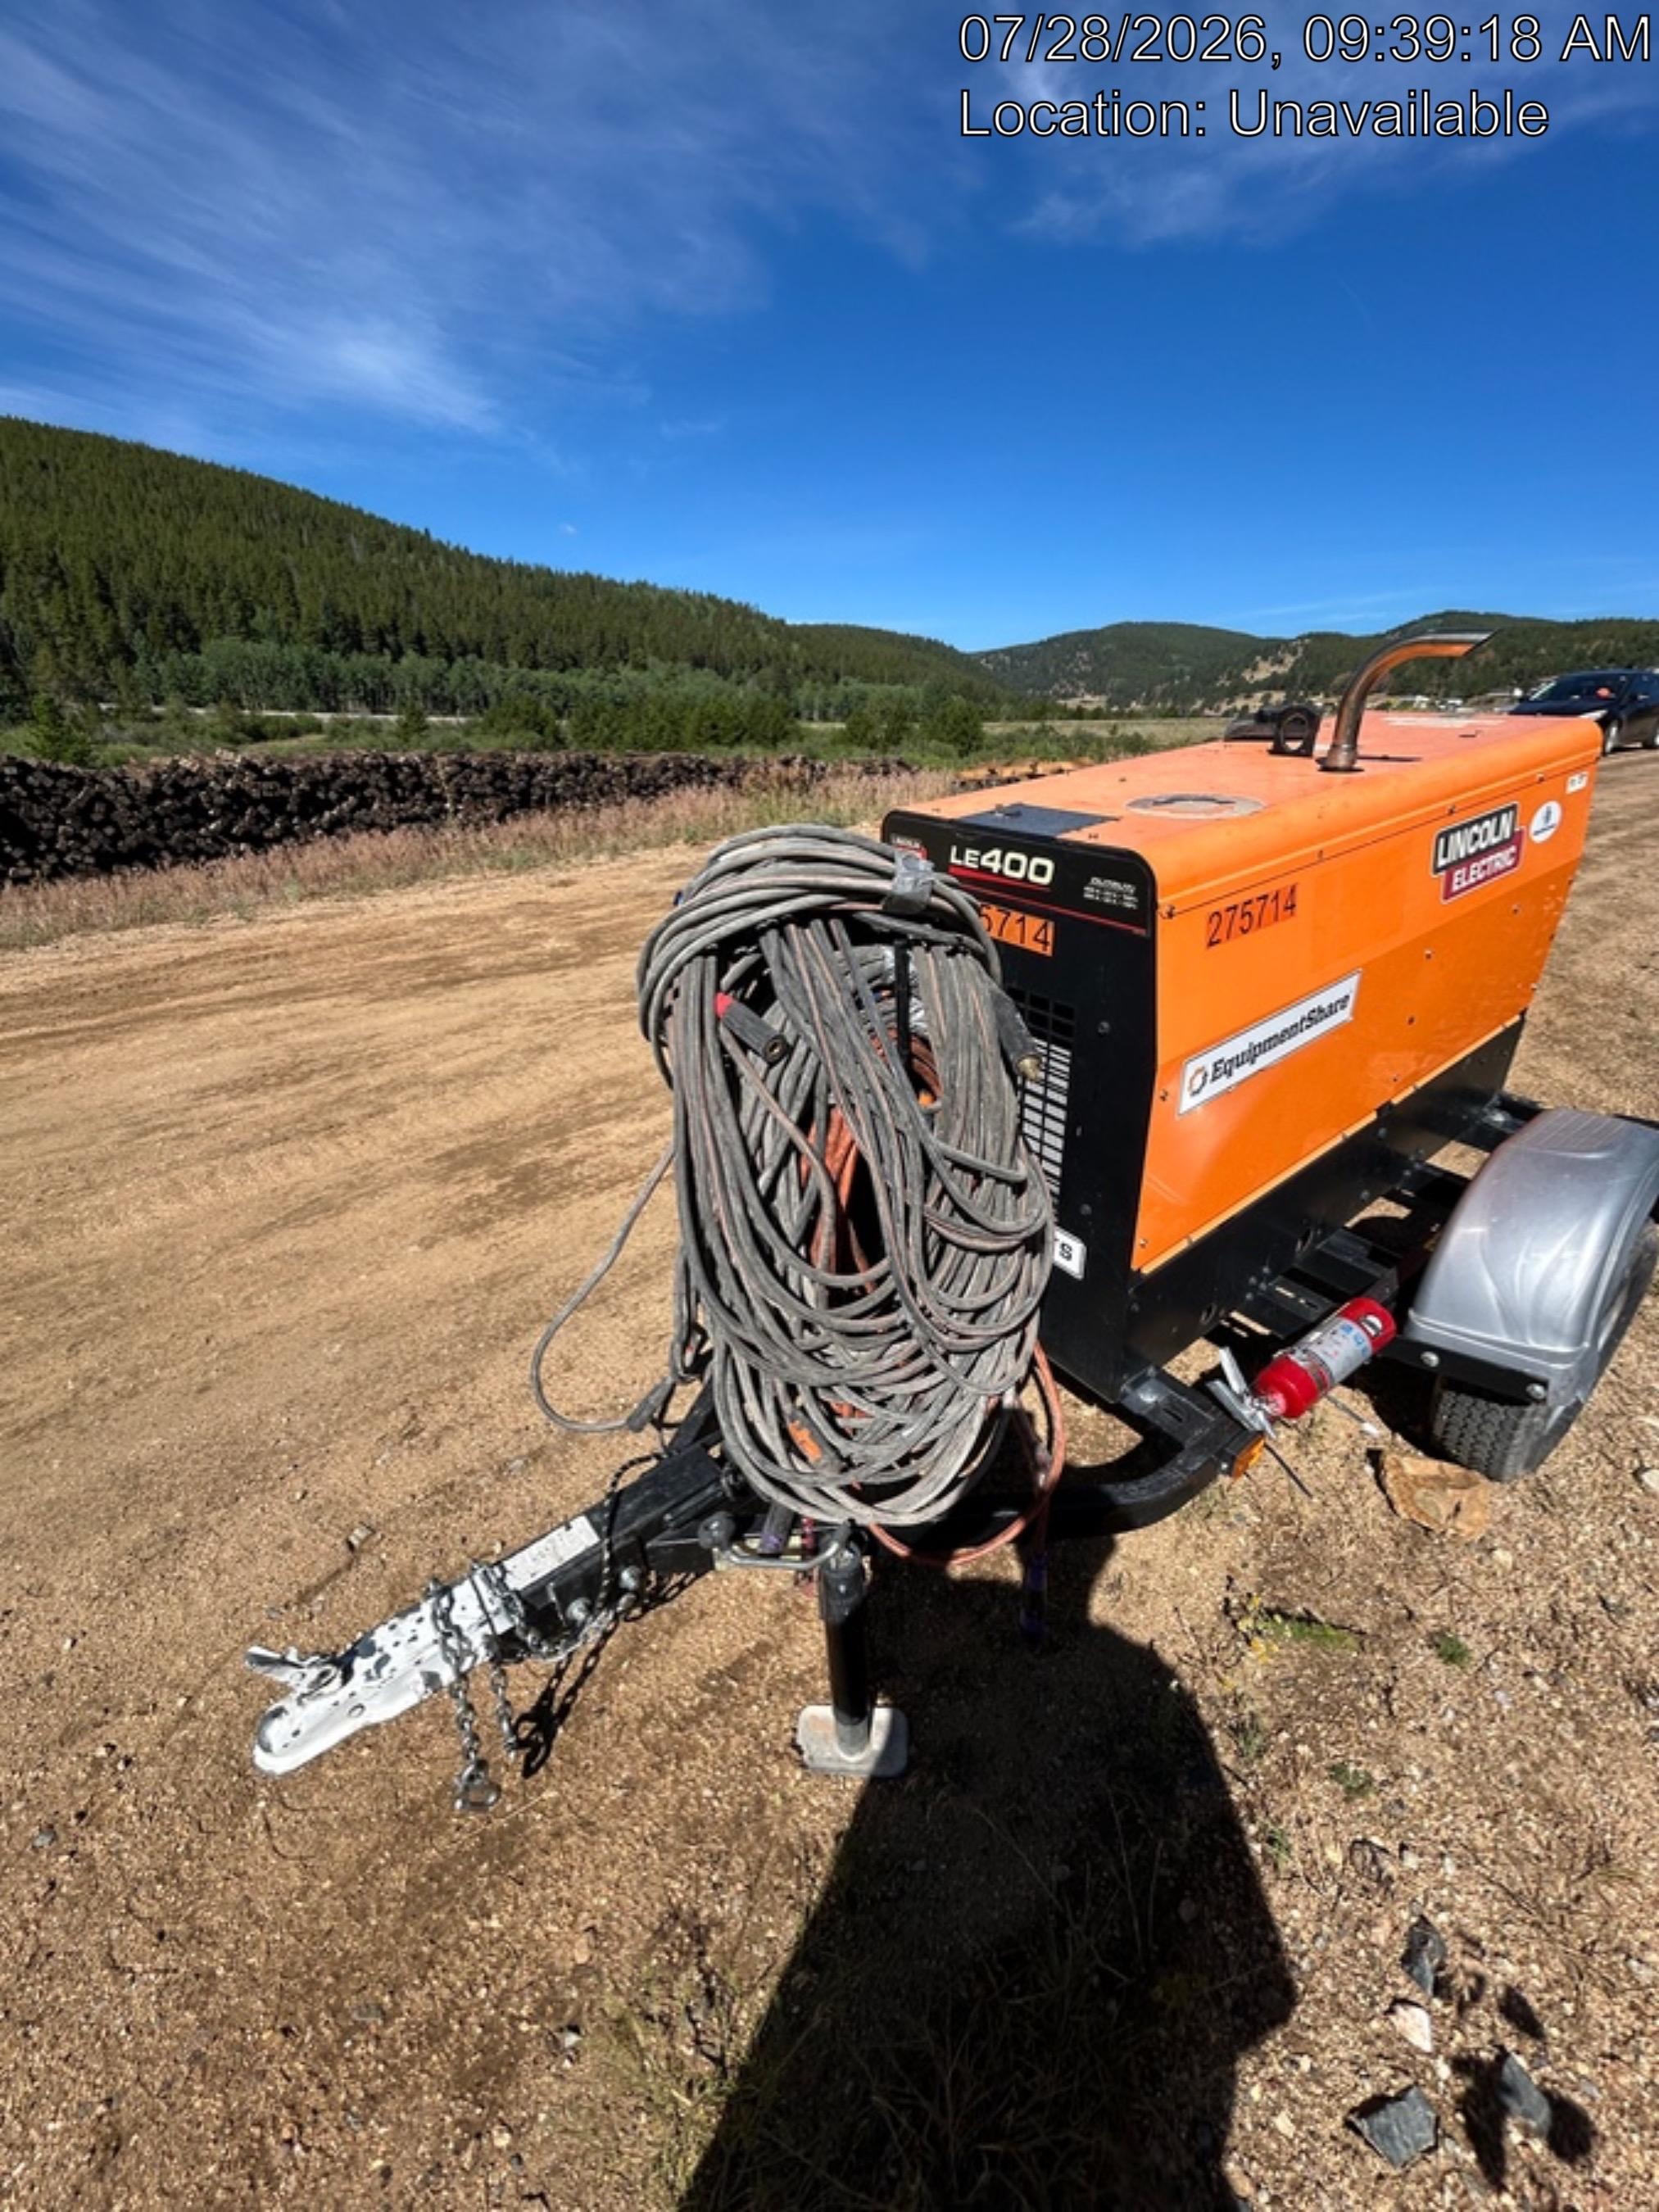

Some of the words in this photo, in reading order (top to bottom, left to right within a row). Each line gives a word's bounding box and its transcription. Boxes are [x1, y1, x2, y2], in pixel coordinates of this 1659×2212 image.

[950, 844, 1055, 885] LE400
[1437, 809, 1514, 868] LINCOLN
[1451, 845, 1517, 893] ELECTRIC
[978, 904, 1050, 952] 5714
[1206, 883, 1297, 949] 275714
[1209, 993, 1351, 1084] EquipmentShare
